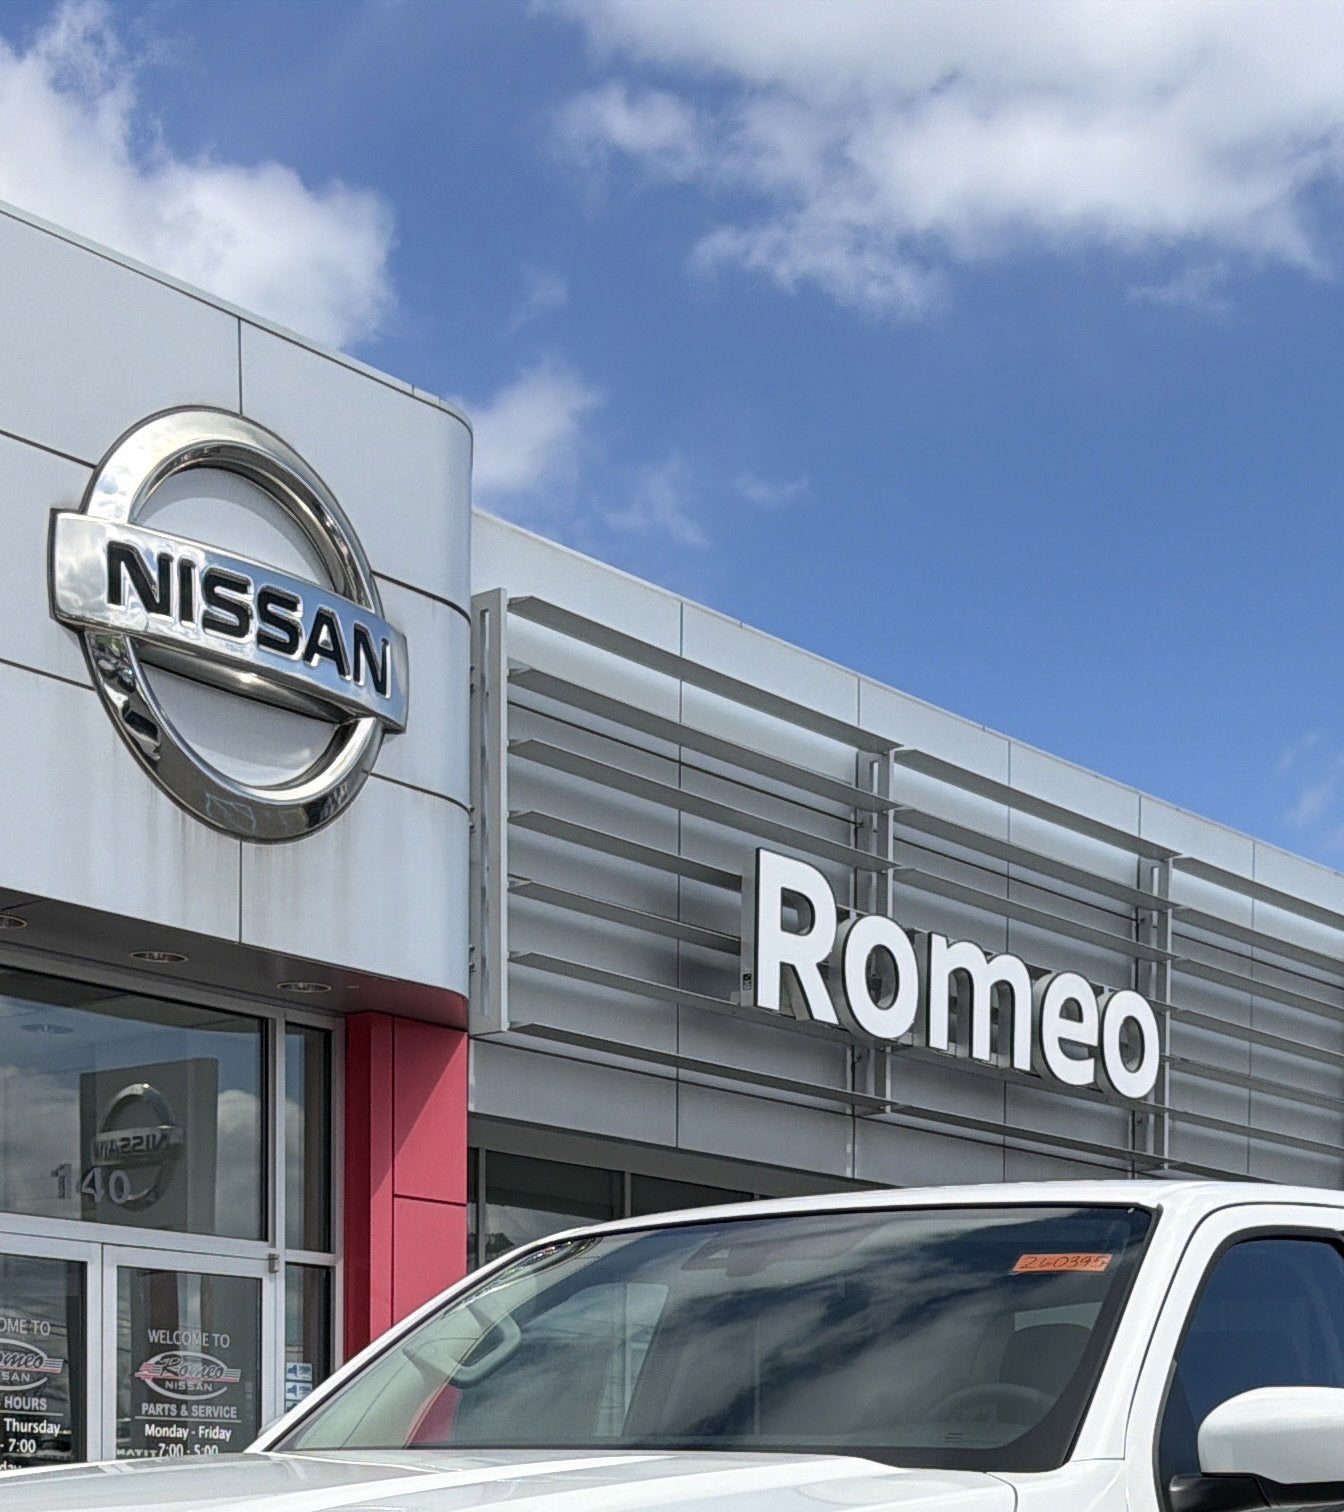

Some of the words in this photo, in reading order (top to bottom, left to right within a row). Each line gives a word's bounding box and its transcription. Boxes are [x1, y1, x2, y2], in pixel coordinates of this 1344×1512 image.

[106, 540, 391, 699] NISSAN
[756, 847, 1160, 1098] Romeo
[51, 1163, 130, 1204] 140
[31, 1319, 51, 1336] TO
[148, 1329, 209, 1347] WELCOME
[212, 1334, 230, 1348] TO
[159, 1354, 224, 1378] Romeo
[165, 1380, 213, 1392] NISSAN
[4, 1397, 47, 1411] HOURS
[141, 1403, 177, 1416] PARTS
[180, 1405, 188, 1416] &
[191, 1406, 237, 1418] SERVICE
[4, 1418, 62, 1437] Thursday
[145, 1424, 189, 1440] Monday
[199, 1426, 232, 1442] Friday
[8, 1438, 36, 1453] 7:00
[158, 1443, 183, 1457] 7:00
